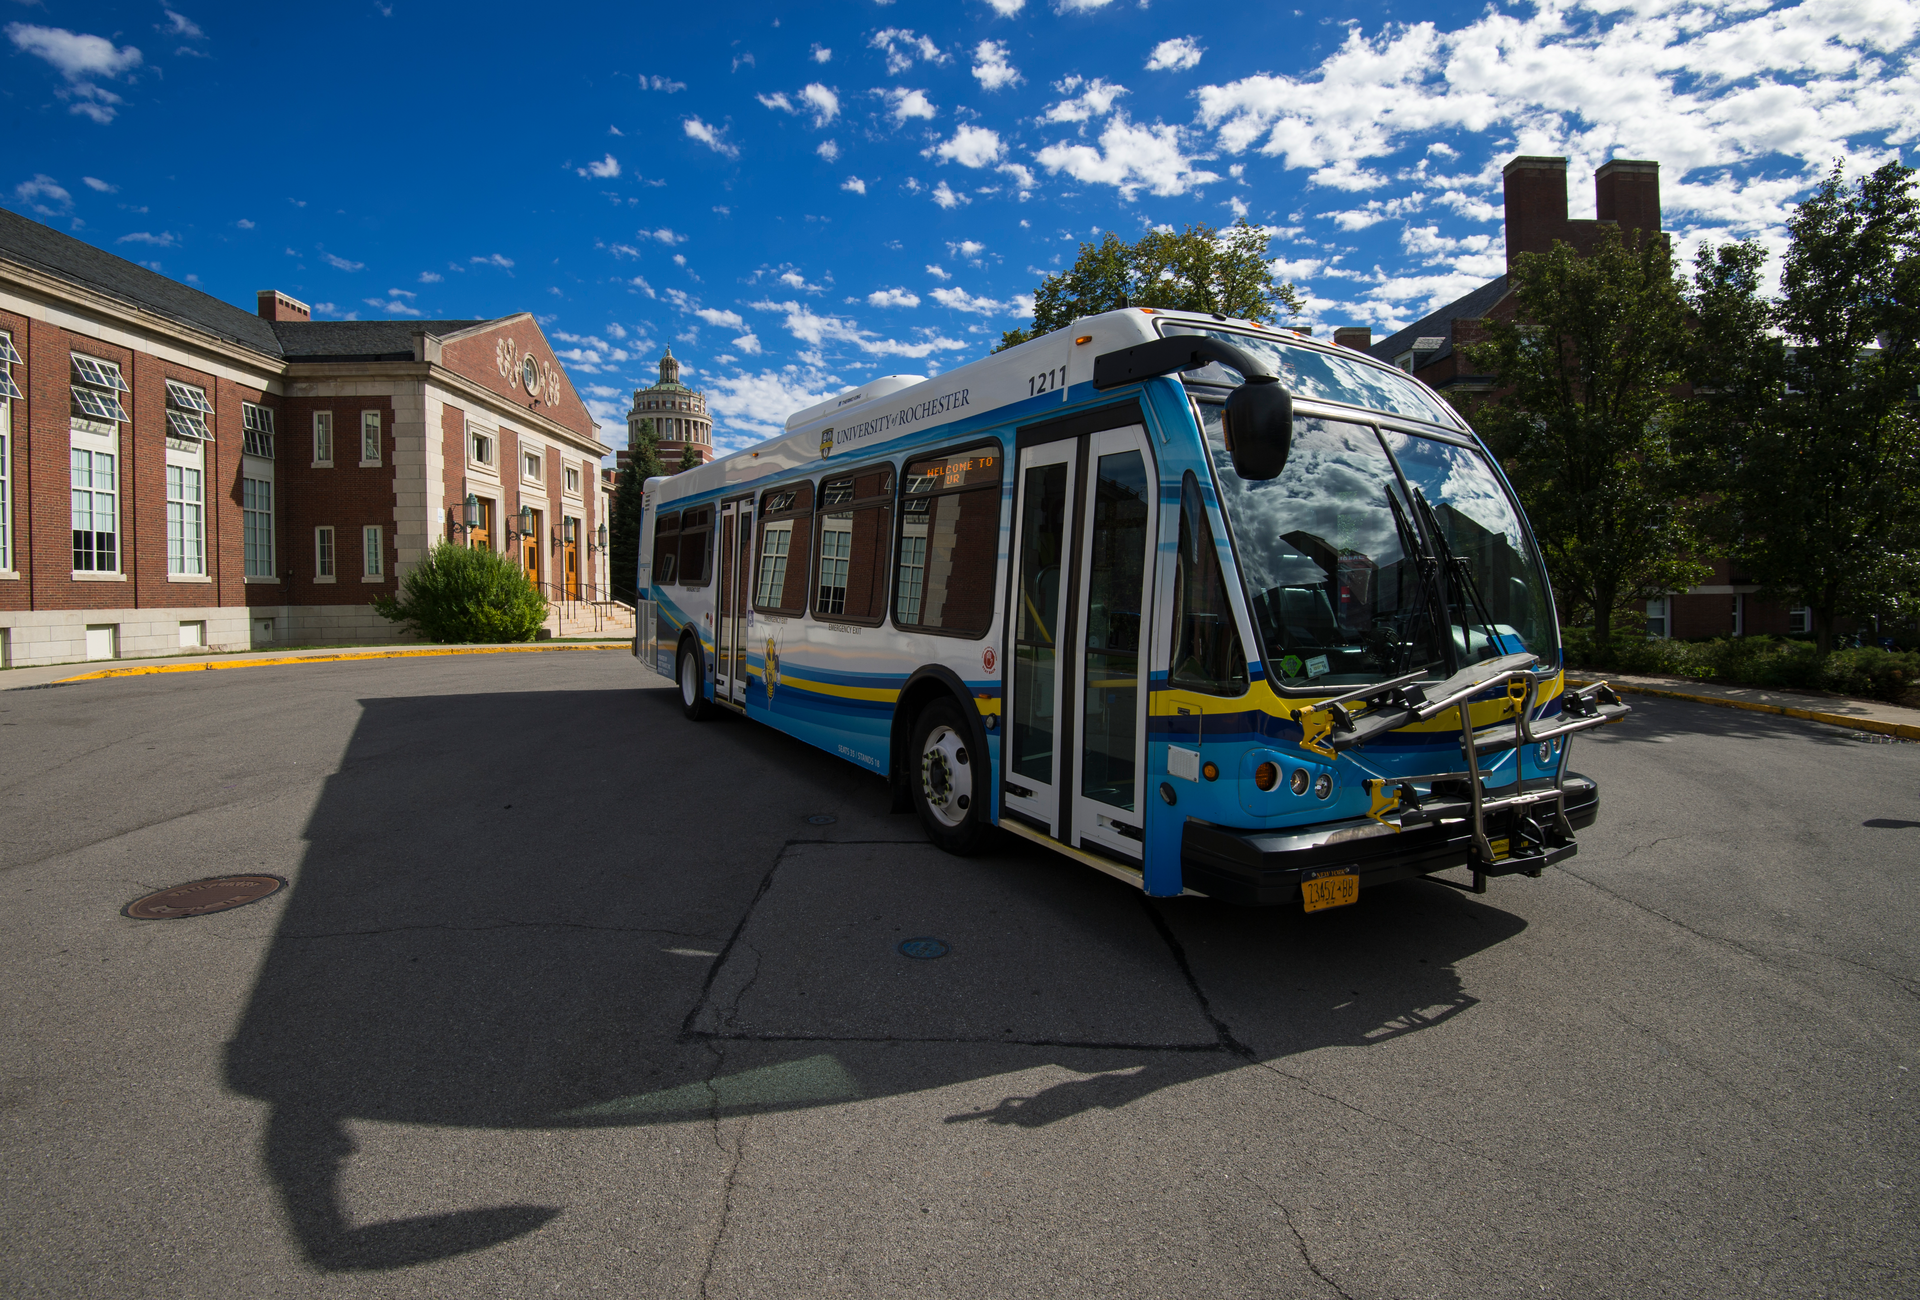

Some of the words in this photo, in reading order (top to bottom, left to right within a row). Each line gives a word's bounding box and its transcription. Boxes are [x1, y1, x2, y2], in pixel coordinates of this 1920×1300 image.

[1028, 365, 1066, 396] 1211
[837, 414, 892, 444] UNIVERSITY
[891, 413, 899, 426] of
[899, 388, 970, 426] ROCHESTER
[927, 460, 973, 477] WELCOME
[978, 456, 993, 468] TO
[946, 473, 960, 484] UR
[828, 623, 852, 634] EMERGENCY
[852, 627, 862, 635] EXIT
[838, 744, 850, 756] SEATS
[858, 752, 874, 766] STANDS
[1316, 870, 1330, 878] NEW
[1331, 868, 1346, 877] YORK
